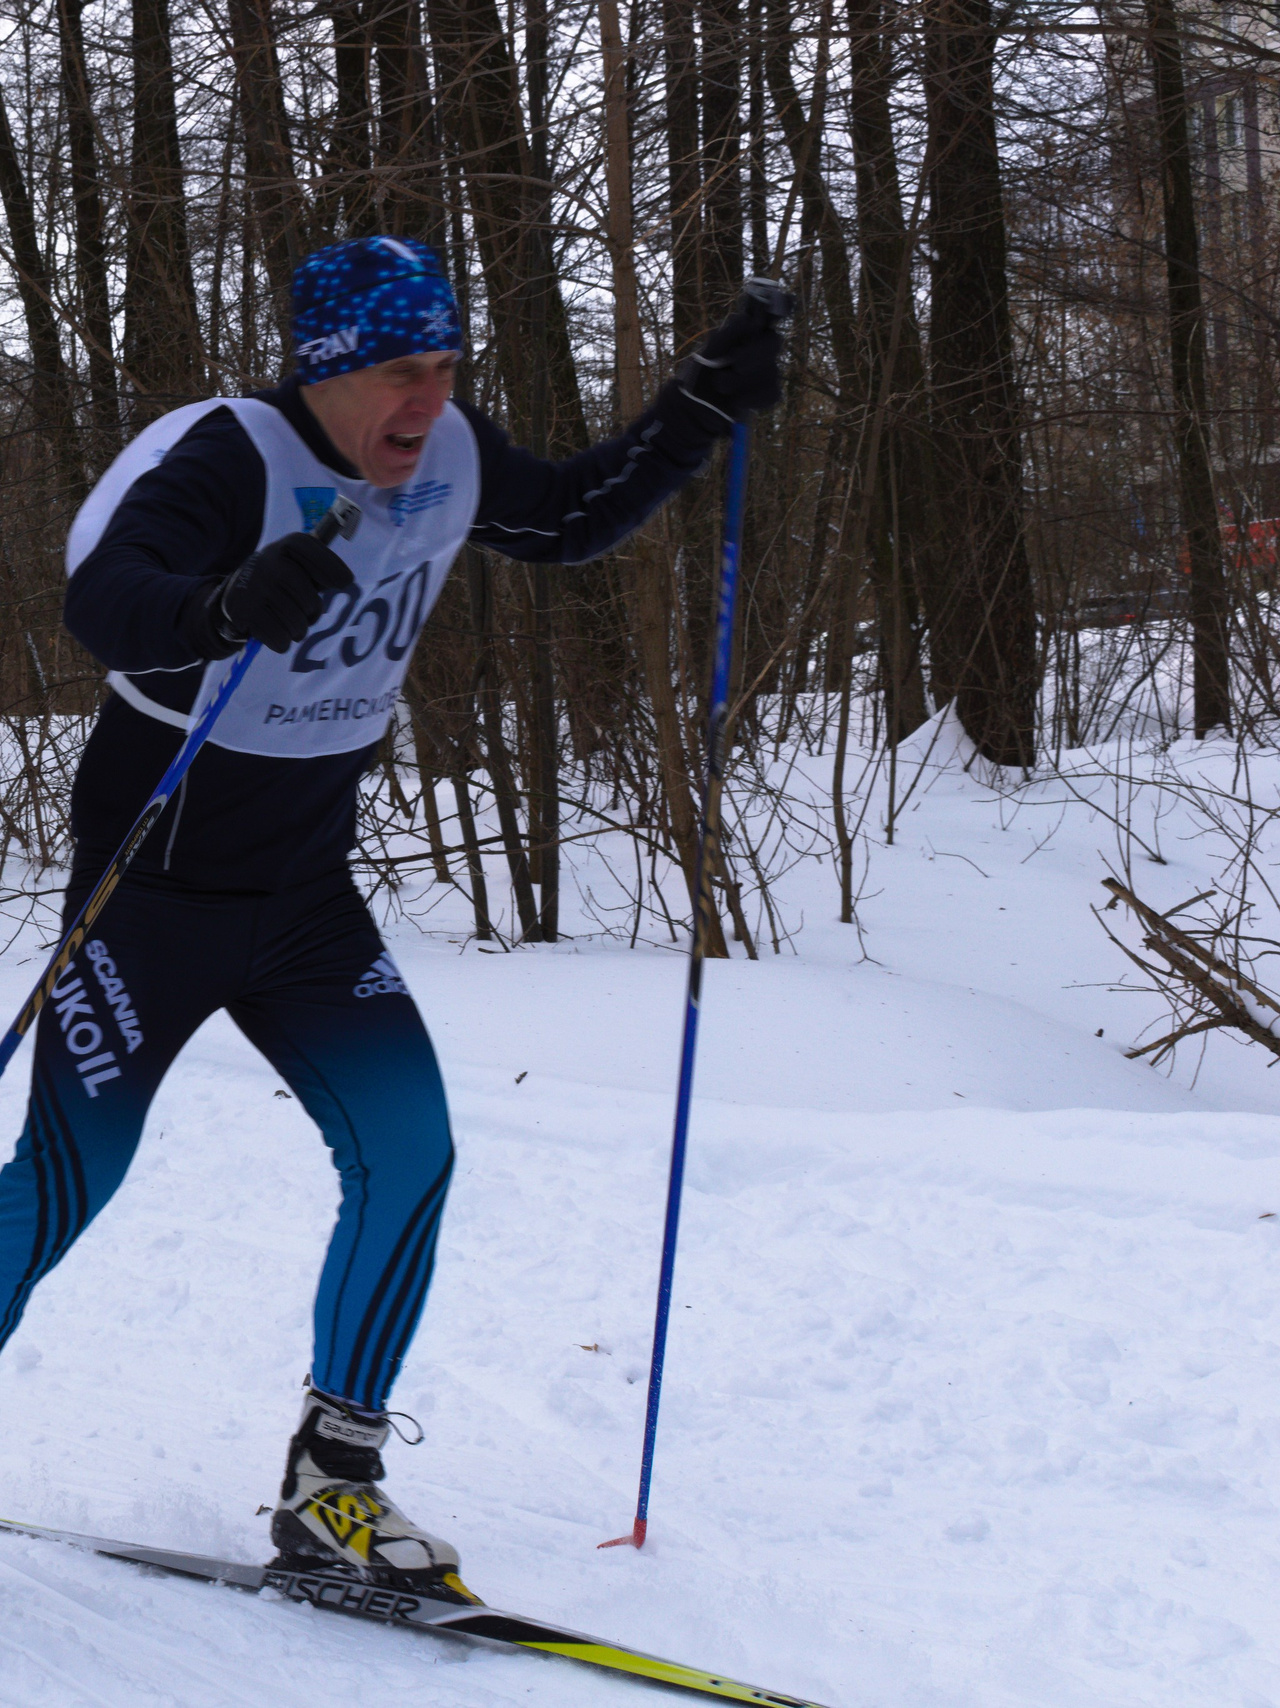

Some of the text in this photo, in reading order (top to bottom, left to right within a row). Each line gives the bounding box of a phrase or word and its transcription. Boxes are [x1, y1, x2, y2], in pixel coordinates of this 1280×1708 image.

[290, 561, 432, 673] 250
[50, 961, 122, 1099] UKOIL
[85, 939, 145, 1055] SCANIA
